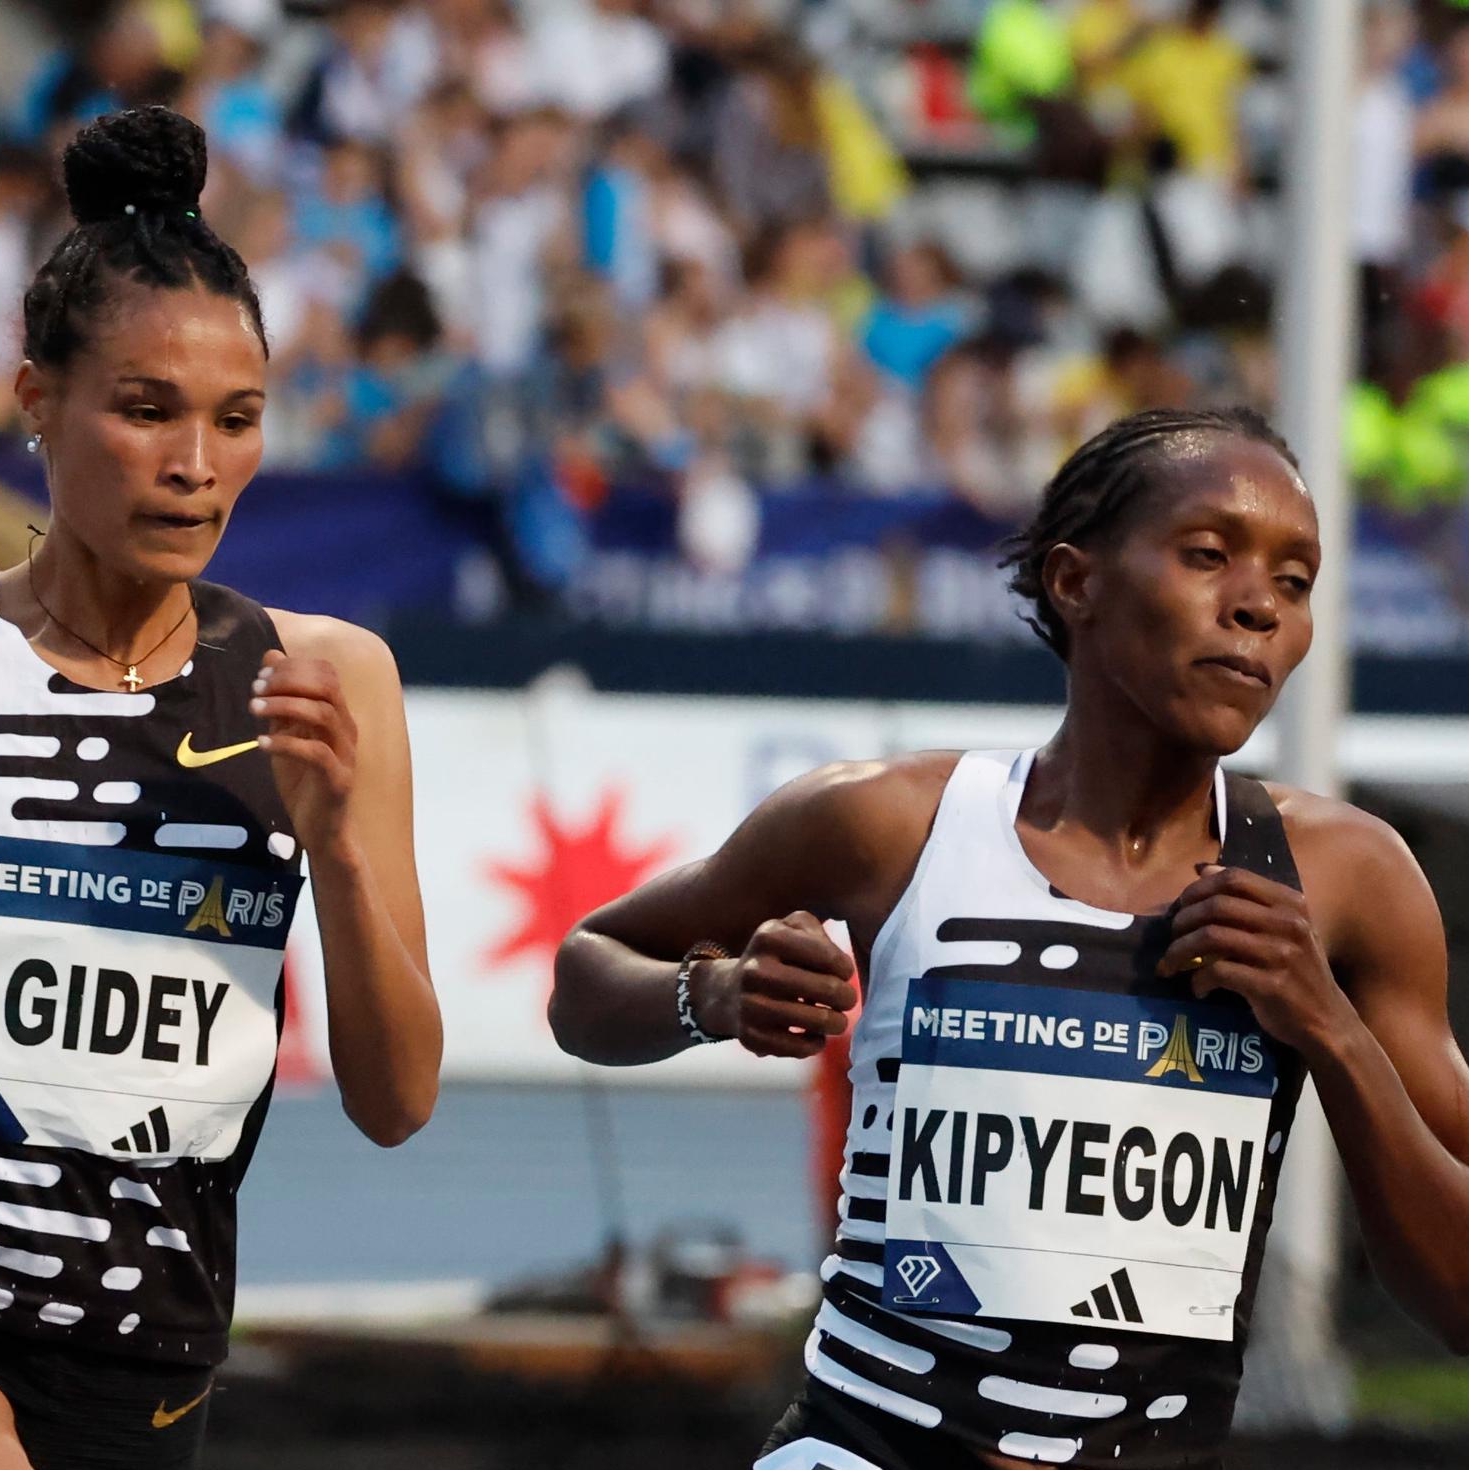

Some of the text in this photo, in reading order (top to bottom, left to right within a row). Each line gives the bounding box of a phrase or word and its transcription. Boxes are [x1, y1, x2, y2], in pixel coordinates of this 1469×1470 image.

[140, 878, 171, 902] DE
[177, 873, 285, 938] PARIS
[4, 958, 230, 1067] GIDEY
[909, 1005, 1265, 1084] MEETING DE PARIS
[897, 1106, 1255, 1233] KIPYEGON
